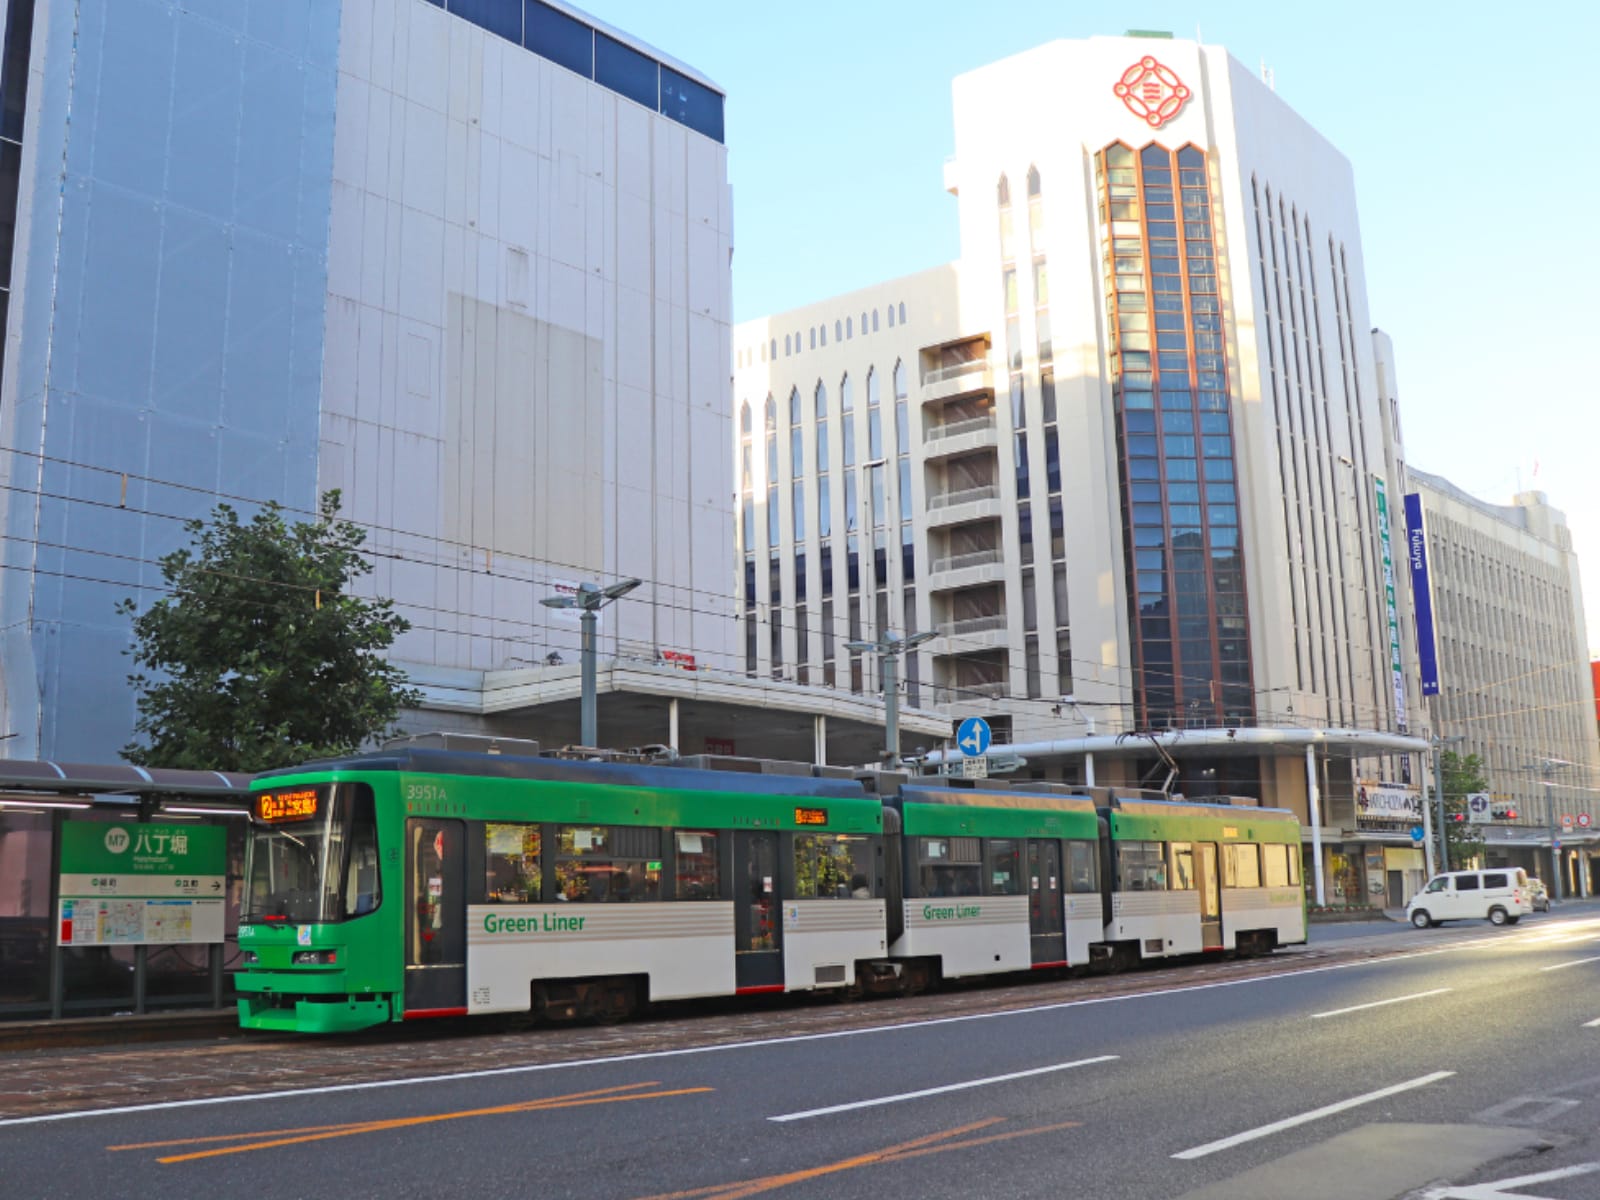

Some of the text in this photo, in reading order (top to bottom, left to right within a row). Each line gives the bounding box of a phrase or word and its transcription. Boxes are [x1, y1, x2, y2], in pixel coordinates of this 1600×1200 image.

[1411, 528, 1423, 570] Fukuya
[407, 784, 448, 800] 3951A
[108, 834, 188, 855] M7 八丁堀
[483, 912, 585, 933] Green Liner
[923, 904, 980, 920] Green Liner
